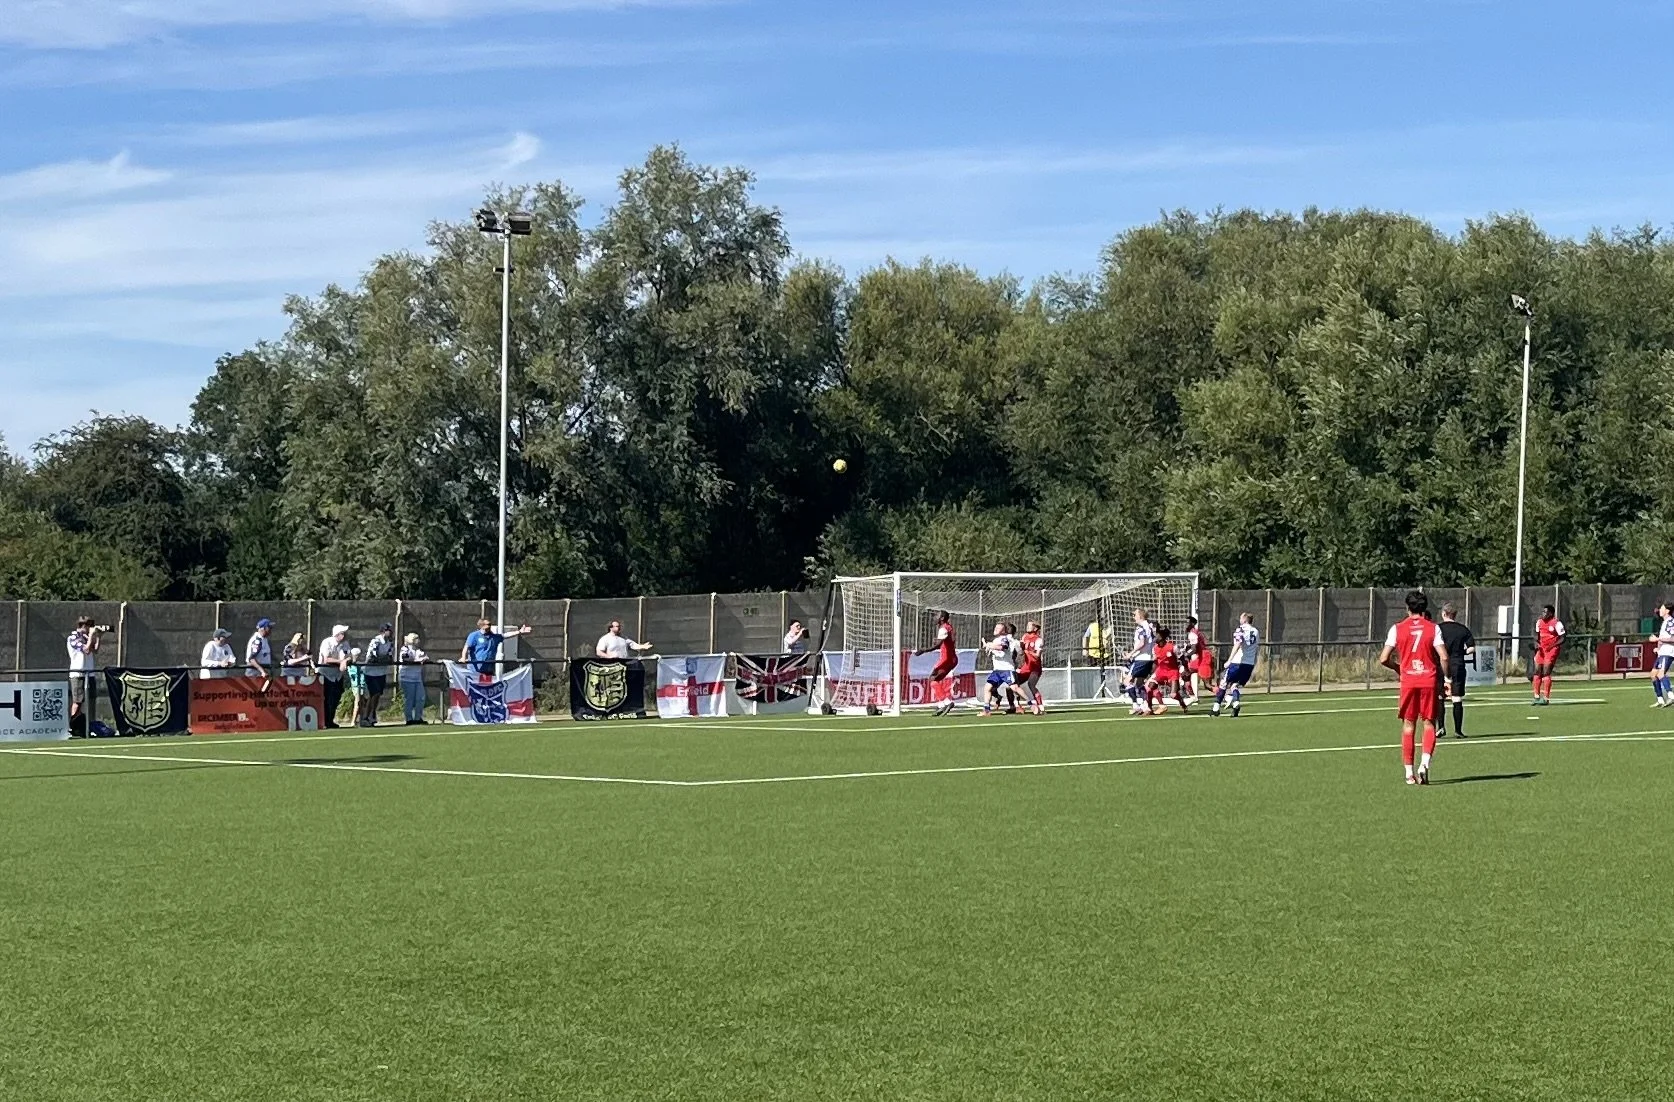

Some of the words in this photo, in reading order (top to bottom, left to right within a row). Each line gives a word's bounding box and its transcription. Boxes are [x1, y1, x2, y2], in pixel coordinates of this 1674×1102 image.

[1410, 629, 1423, 653] 7
[193, 690, 248, 702] Supporting
[18, 727, 64, 735] ACADEMY
